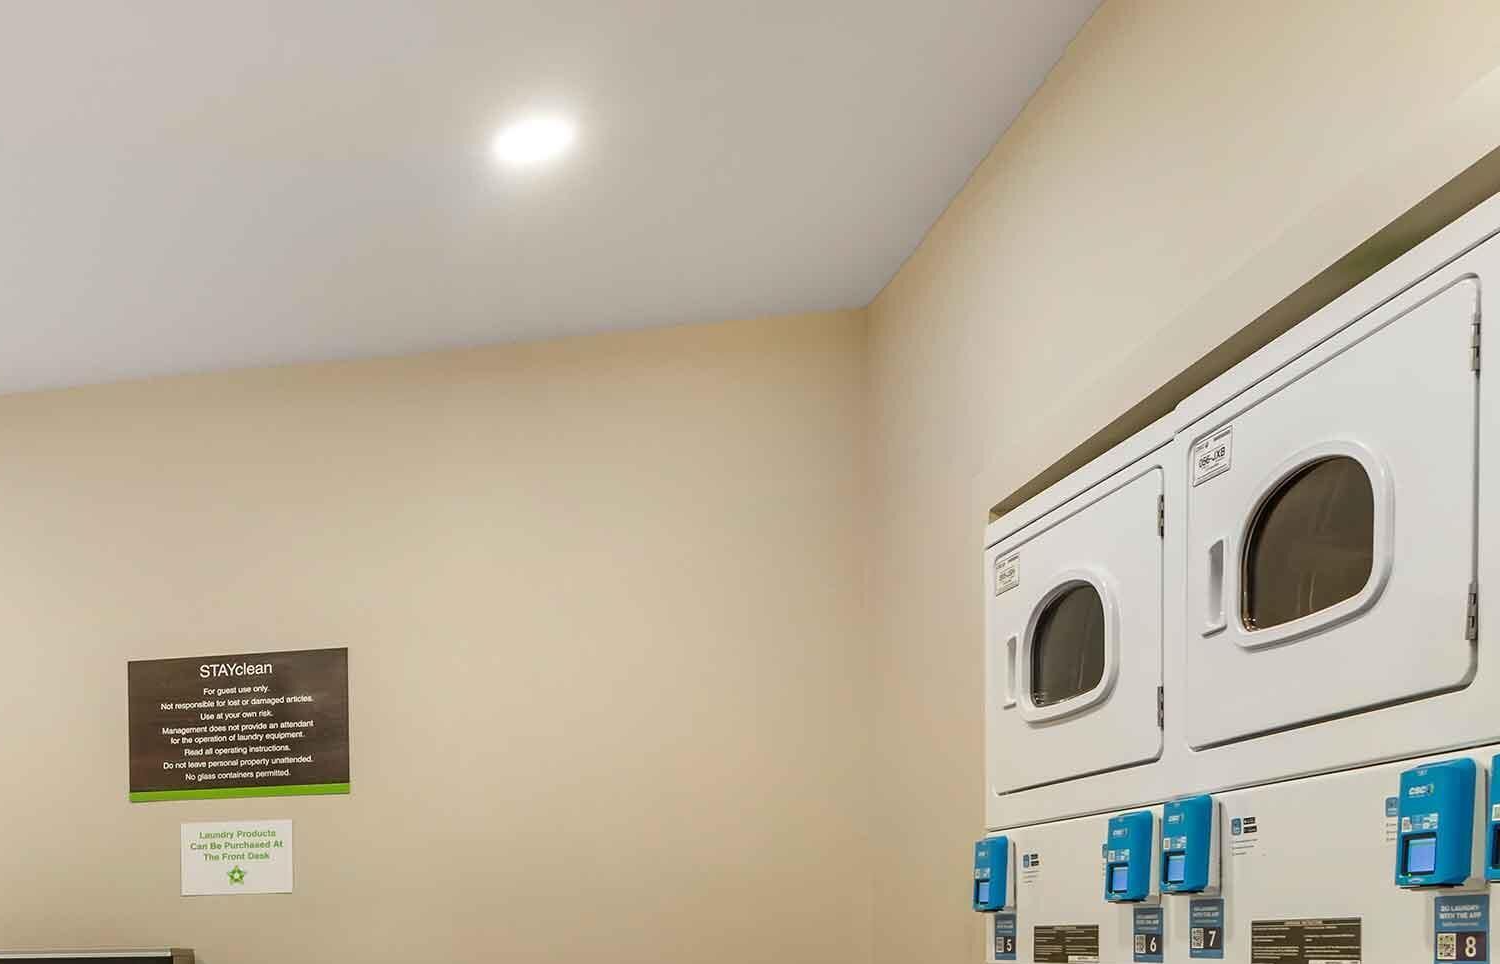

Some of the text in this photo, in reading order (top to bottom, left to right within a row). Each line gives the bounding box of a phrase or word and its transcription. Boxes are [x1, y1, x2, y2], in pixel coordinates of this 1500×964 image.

[199, 662, 273, 678] STAYclean
[203, 684, 271, 697] For guest use only.
[174, 700, 215, 710] responsible
[227, 699, 240, 707] lost
[250, 696, 285, 706] damaged
[286, 695, 315, 703] articles.
[200, 712, 215, 720] Use
[216, 712, 224, 720] at
[224, 712, 240, 721] your
[258, 709, 274, 717] risk.
[162, 725, 208, 736] Management
[208, 724, 227, 732] does
[241, 722, 267, 732] provide
[280, 719, 314, 729] attendant
[181, 736, 193, 744] the
[194, 735, 227, 744] operation
[228, 733, 236, 742] of
[237, 733, 264, 741] laundry
[265, 730, 306, 741] equipment.
[184, 744, 291, 756] Read all operating instructions.
[163, 755, 315, 770] Do not leave personal property unattended.
[185, 768, 291, 782] No glass containers permitted.
[199, 829, 276, 840] Laundry Products
[190, 839, 284, 850] Can Be Purchased At
[203, 851, 270, 861] The Front Desk
[1006, 939, 1013, 952] 5
[1149, 937, 1157, 952] 6
[1208, 930, 1216, 947] 7
[1464, 936, 1477, 958] 8
